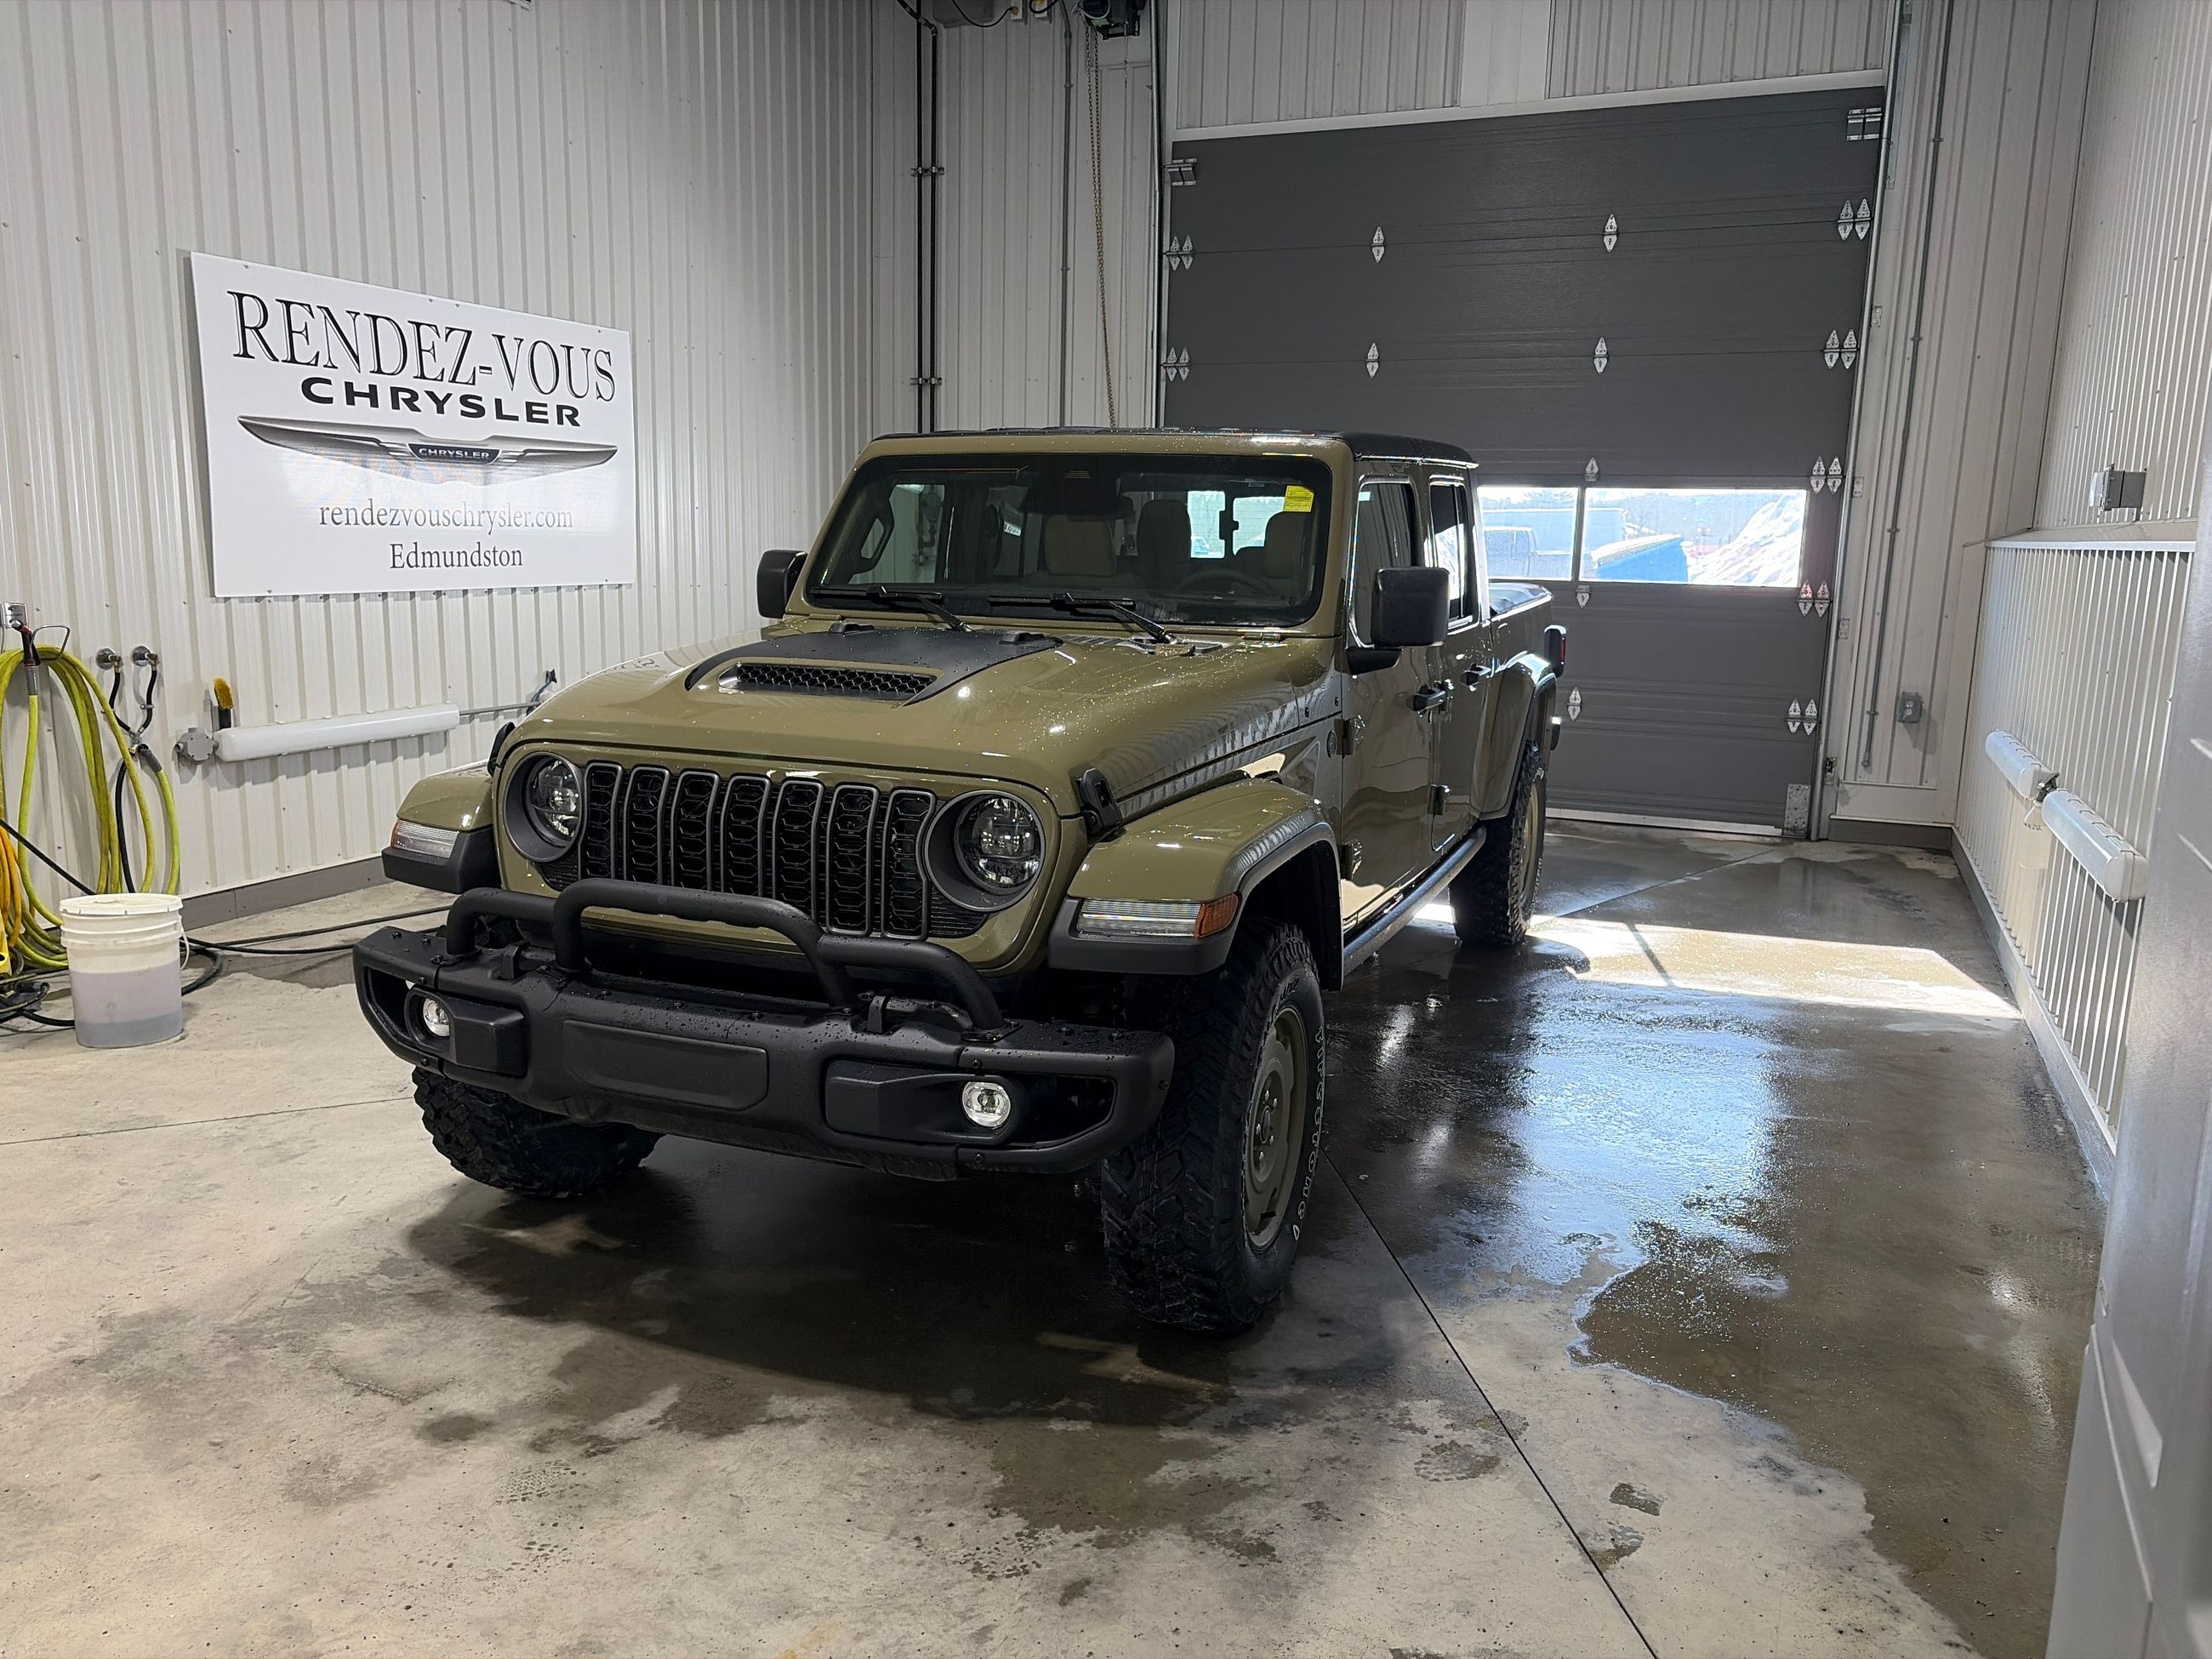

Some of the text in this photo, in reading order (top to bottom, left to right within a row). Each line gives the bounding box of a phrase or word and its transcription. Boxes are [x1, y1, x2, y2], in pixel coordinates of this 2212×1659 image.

[226, 290, 616, 402] RENDEZ-VOUS
[300, 377, 581, 427] CHRYSLER
[419, 448, 491, 459] CHRYSLER
[319, 498, 574, 536] rendezvouschrysler.com
[389, 542, 524, 569] Edmundston
